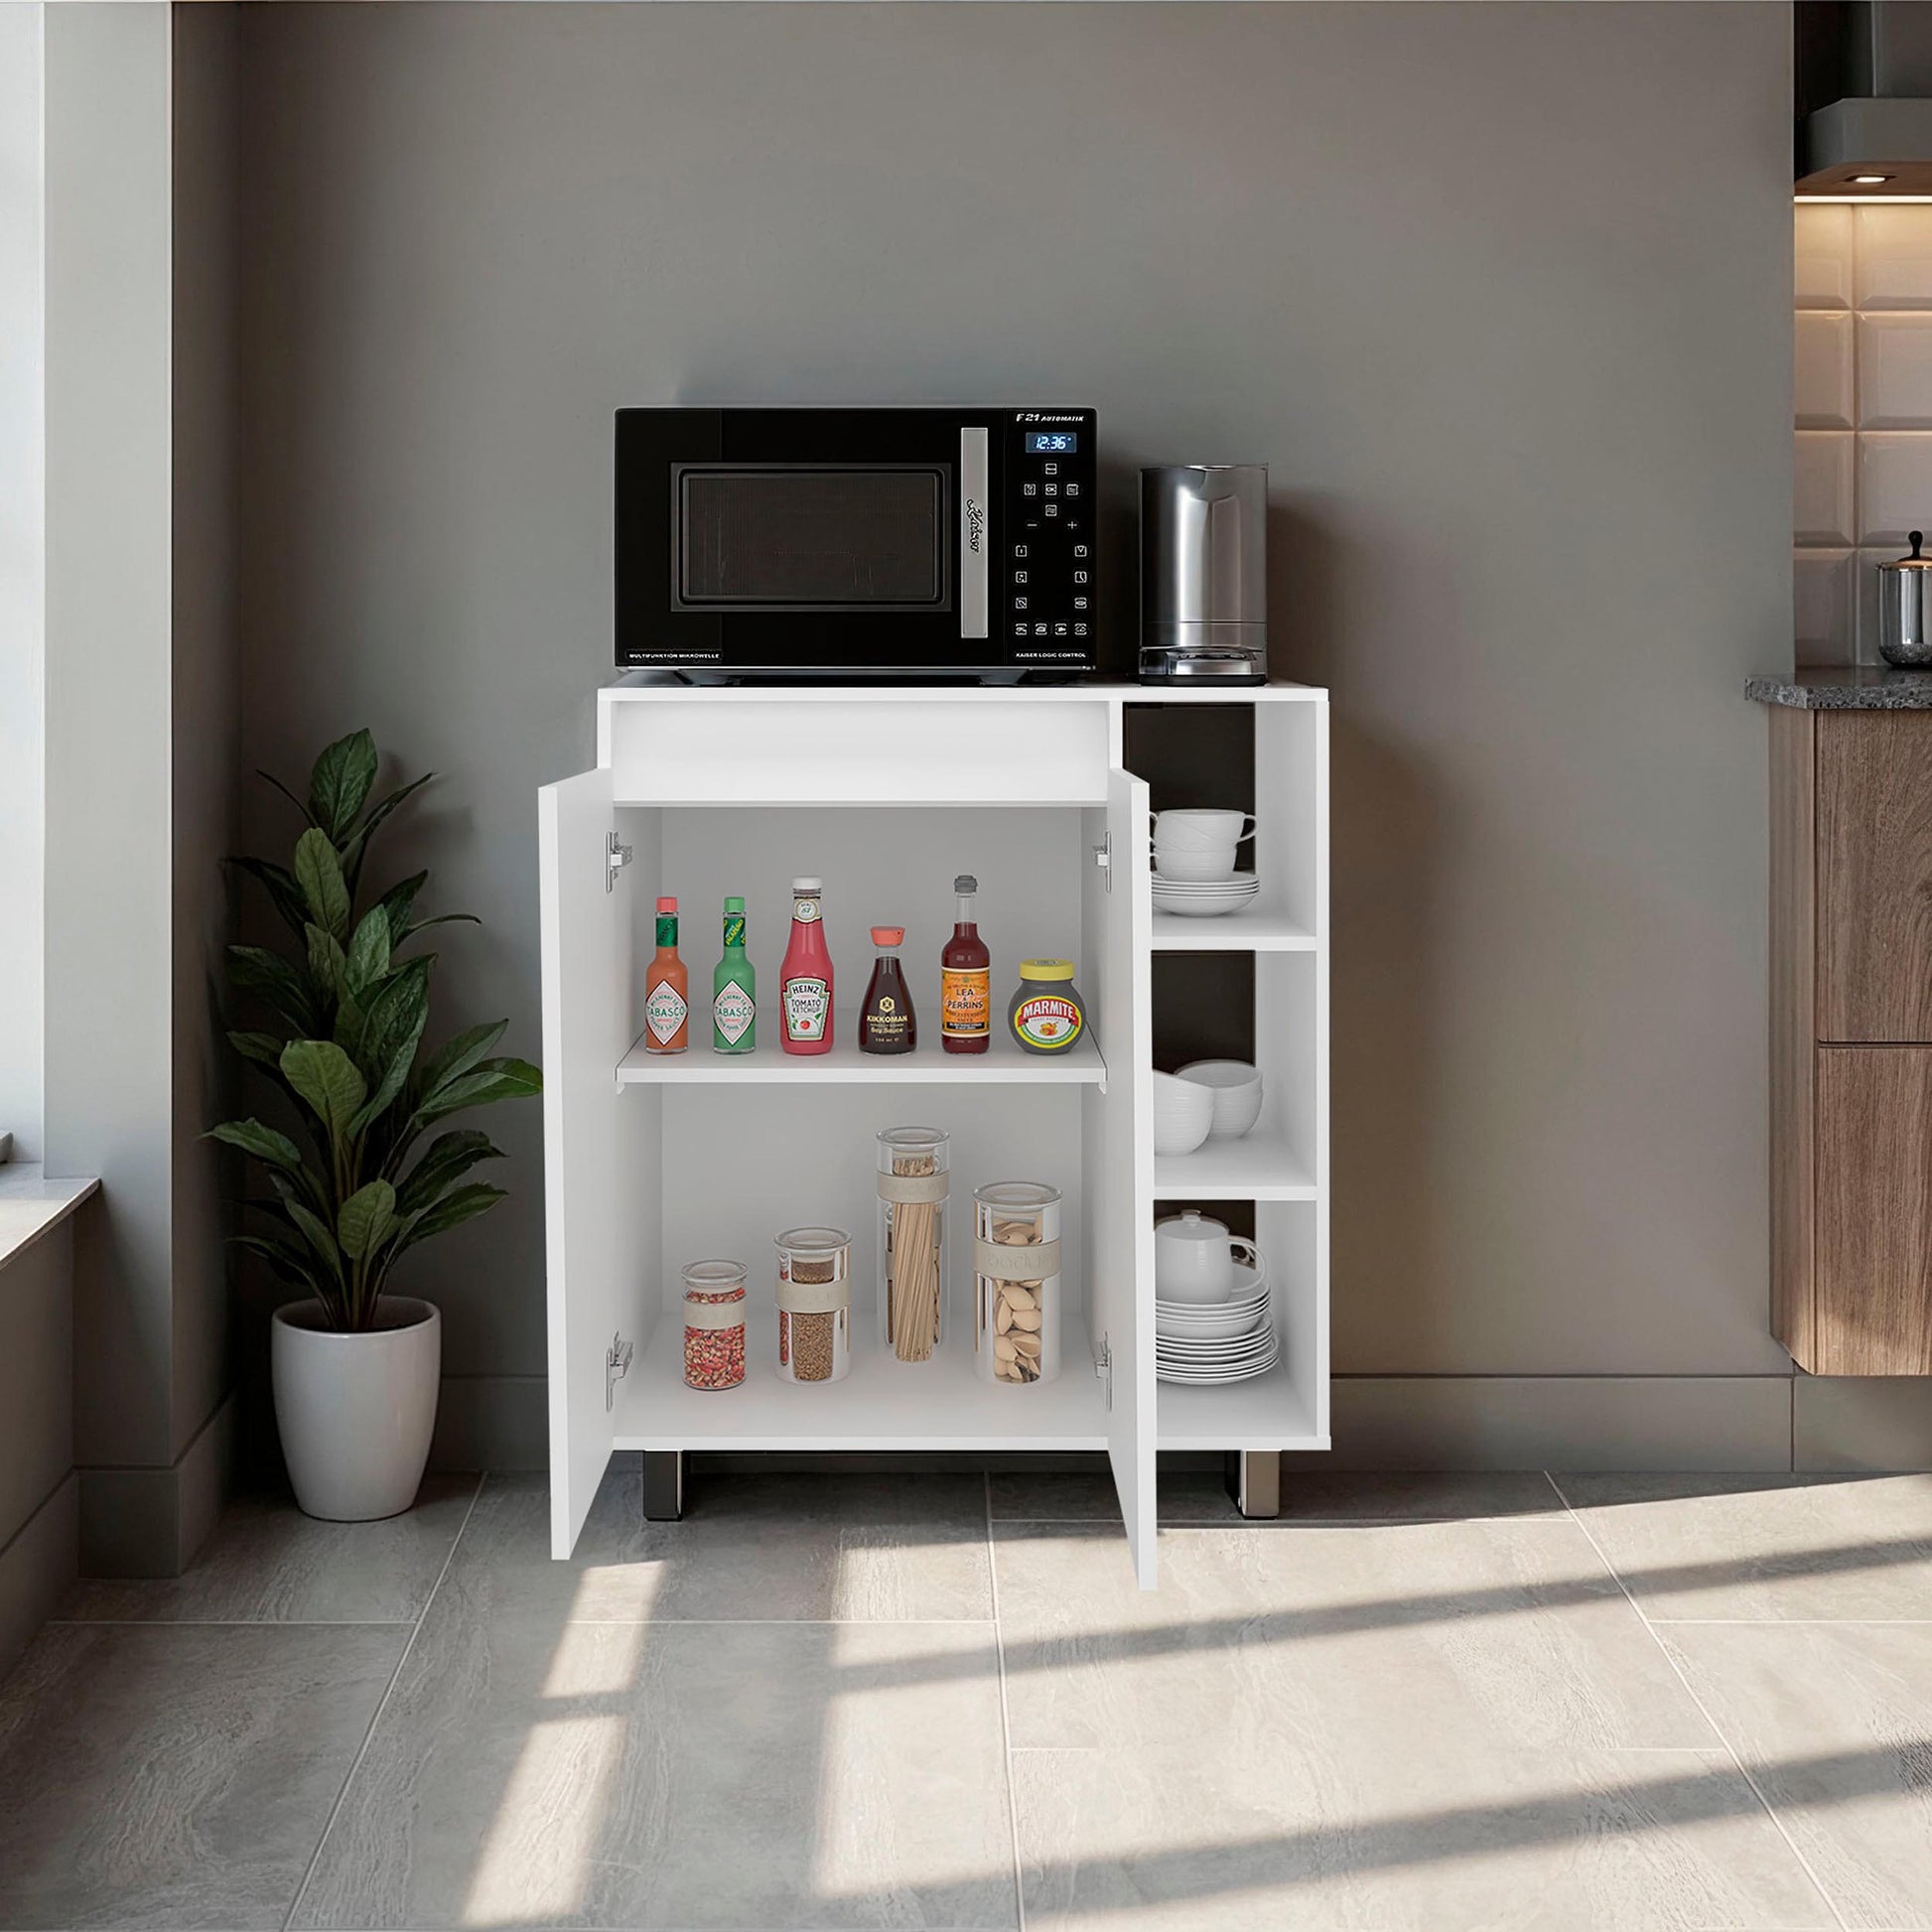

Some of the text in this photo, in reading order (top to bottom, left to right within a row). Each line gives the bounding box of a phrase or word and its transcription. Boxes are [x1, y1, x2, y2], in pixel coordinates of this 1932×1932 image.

[1016, 413, 1026, 422] F
[1025, 413, 1040, 422] 21
[791, 984, 820, 995] HEINZ
[790, 999, 822, 1008] TOMATO
[947, 1000, 984, 1010] PERRINS
[715, 1006, 754, 1018] TABASCO
[1023, 1000, 1075, 1019] MARMITE
[867, 1015, 908, 1024] KIKKOMAN
